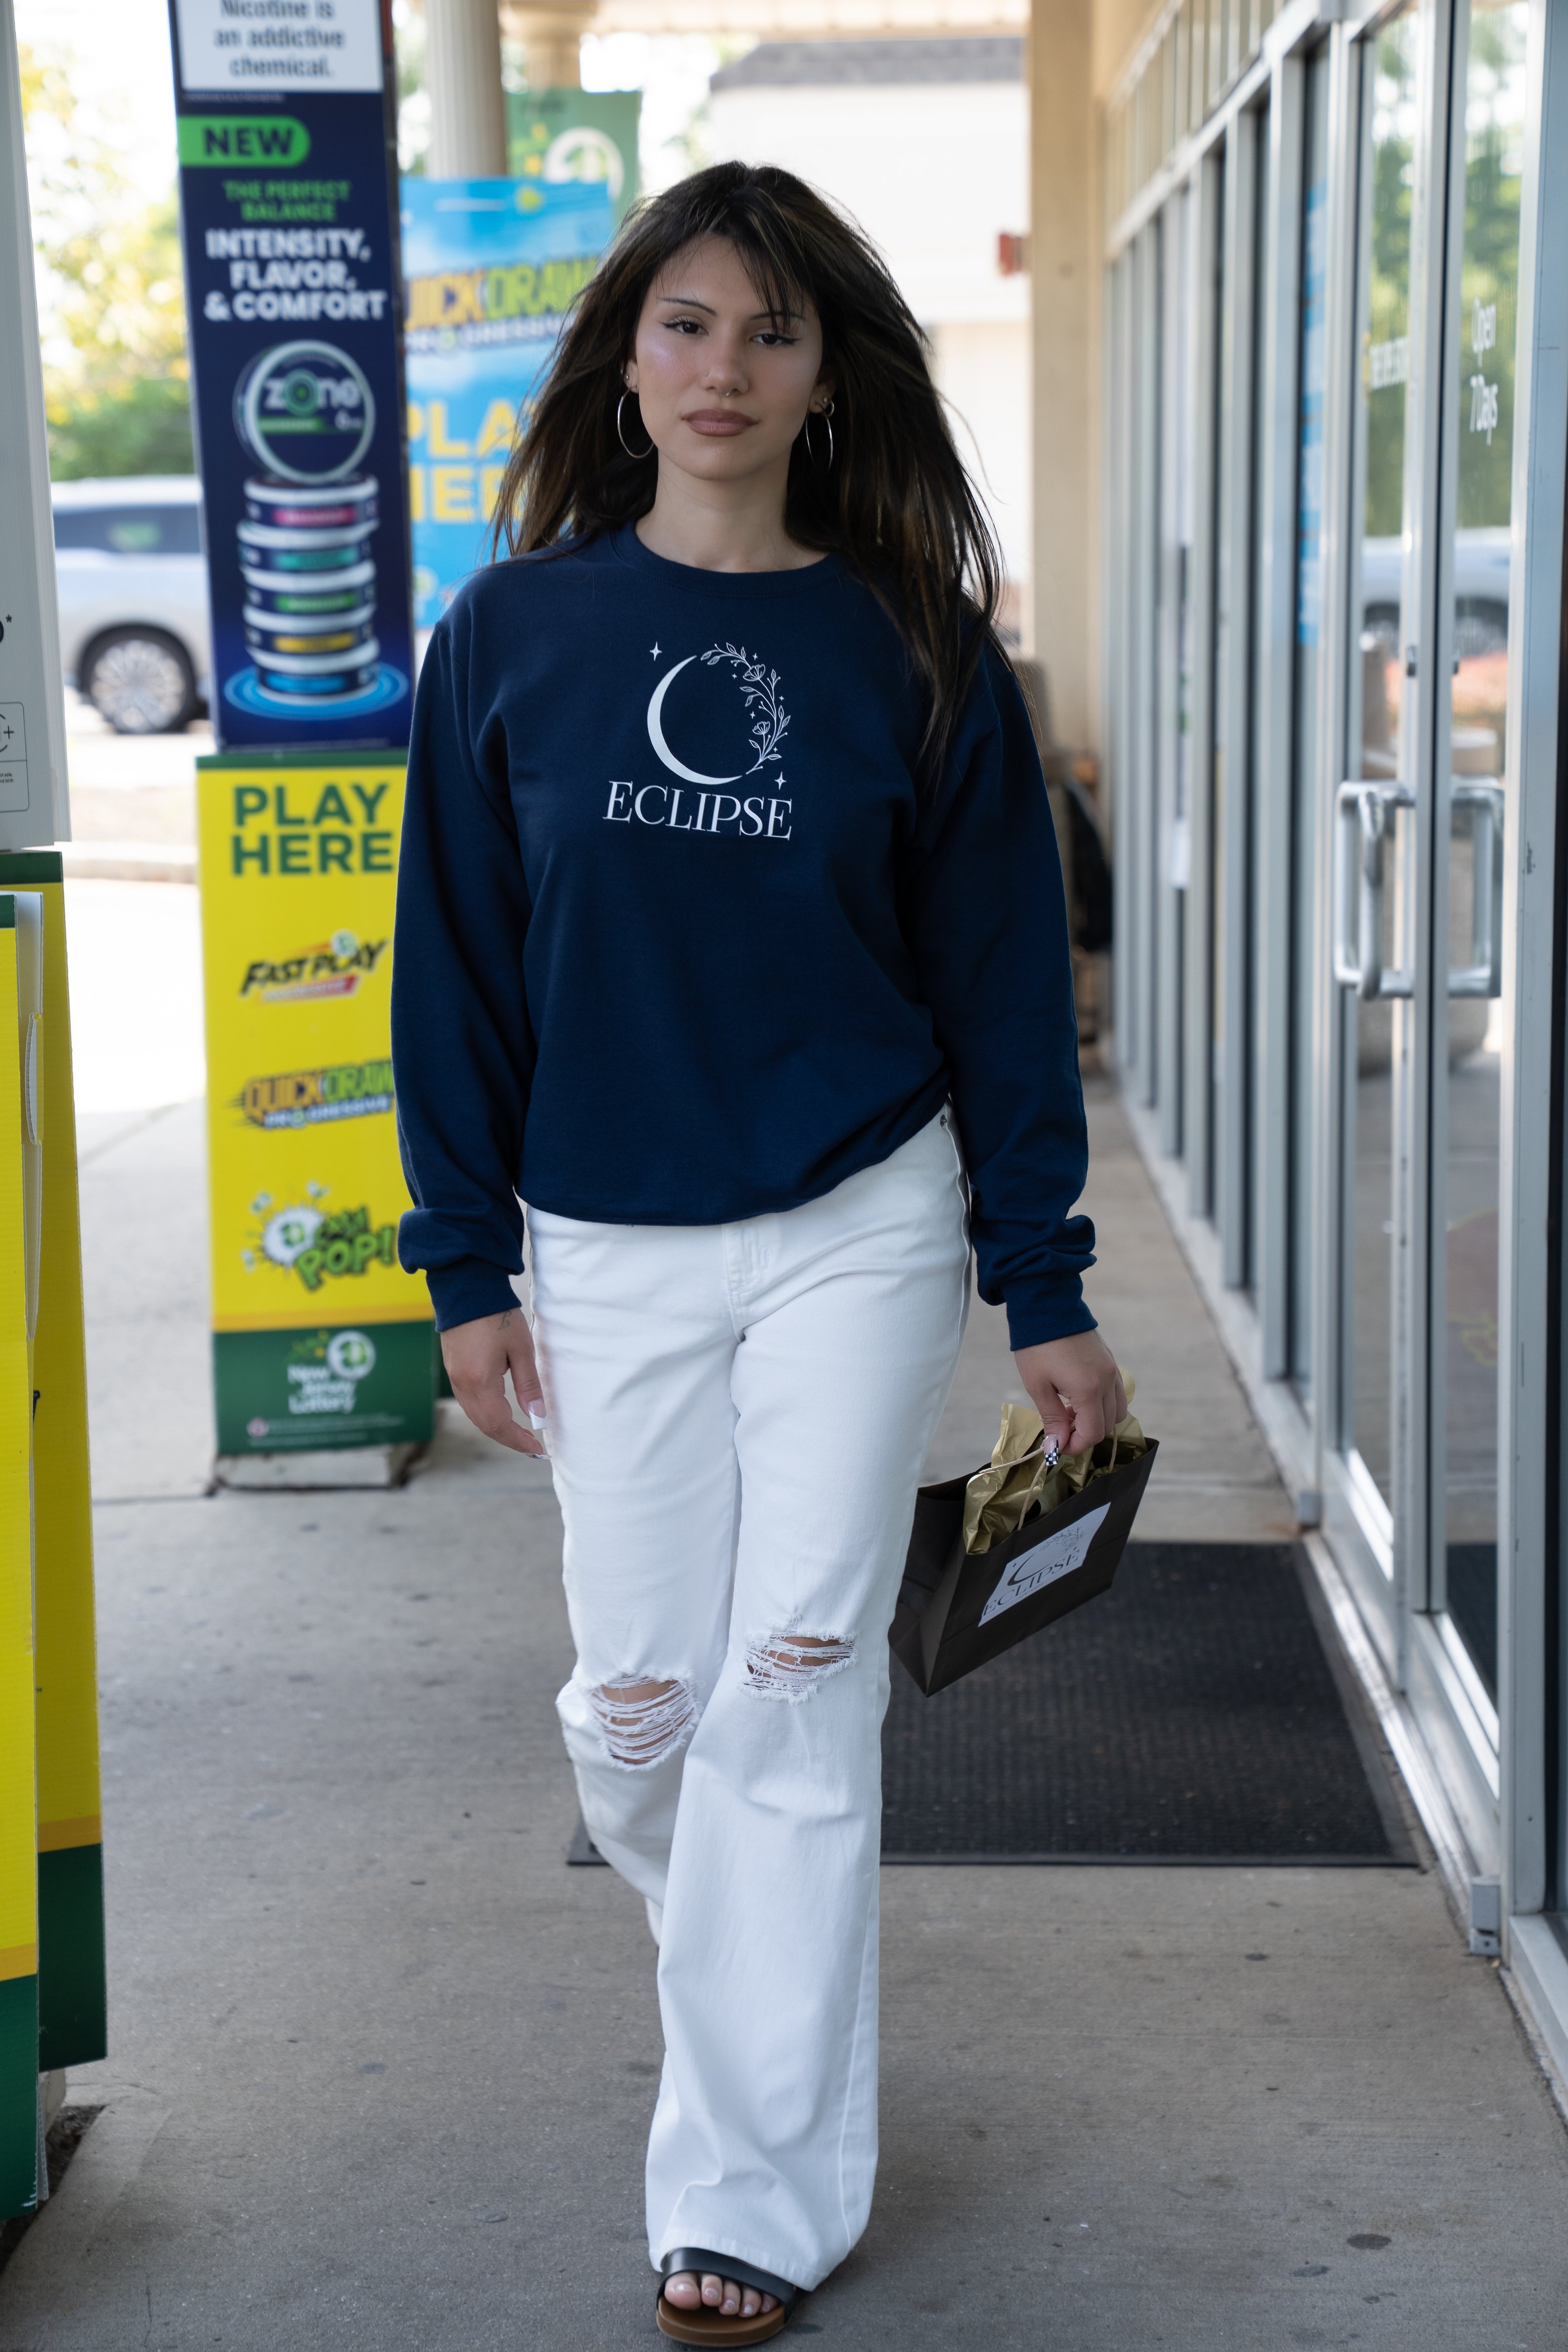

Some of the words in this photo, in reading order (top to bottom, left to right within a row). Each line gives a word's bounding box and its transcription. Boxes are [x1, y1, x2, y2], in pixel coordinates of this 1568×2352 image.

[221, 0, 308, 18] Nicotine
[316, 0, 333, 18] is
[215, 29, 241, 47] an
[247, 26, 345, 48] addictive
[229, 56, 332, 77] chemical.
[204, 127, 296, 156] NEW
[205, 228, 372, 262] INTENSITY,
[229, 260, 358, 292] FLAVOR,
[204, 290, 232, 321] &
[232, 289, 388, 322] COMFORT
[232, 782, 390, 827] PLAY
[602, 780, 792, 841] ECLIPSE
[232, 831, 394, 876] HERE
[241, 956, 310, 997] FAST
[295, 1224, 395, 1291] POP!
[982, 1549, 1080, 1617] ECLIPSE
